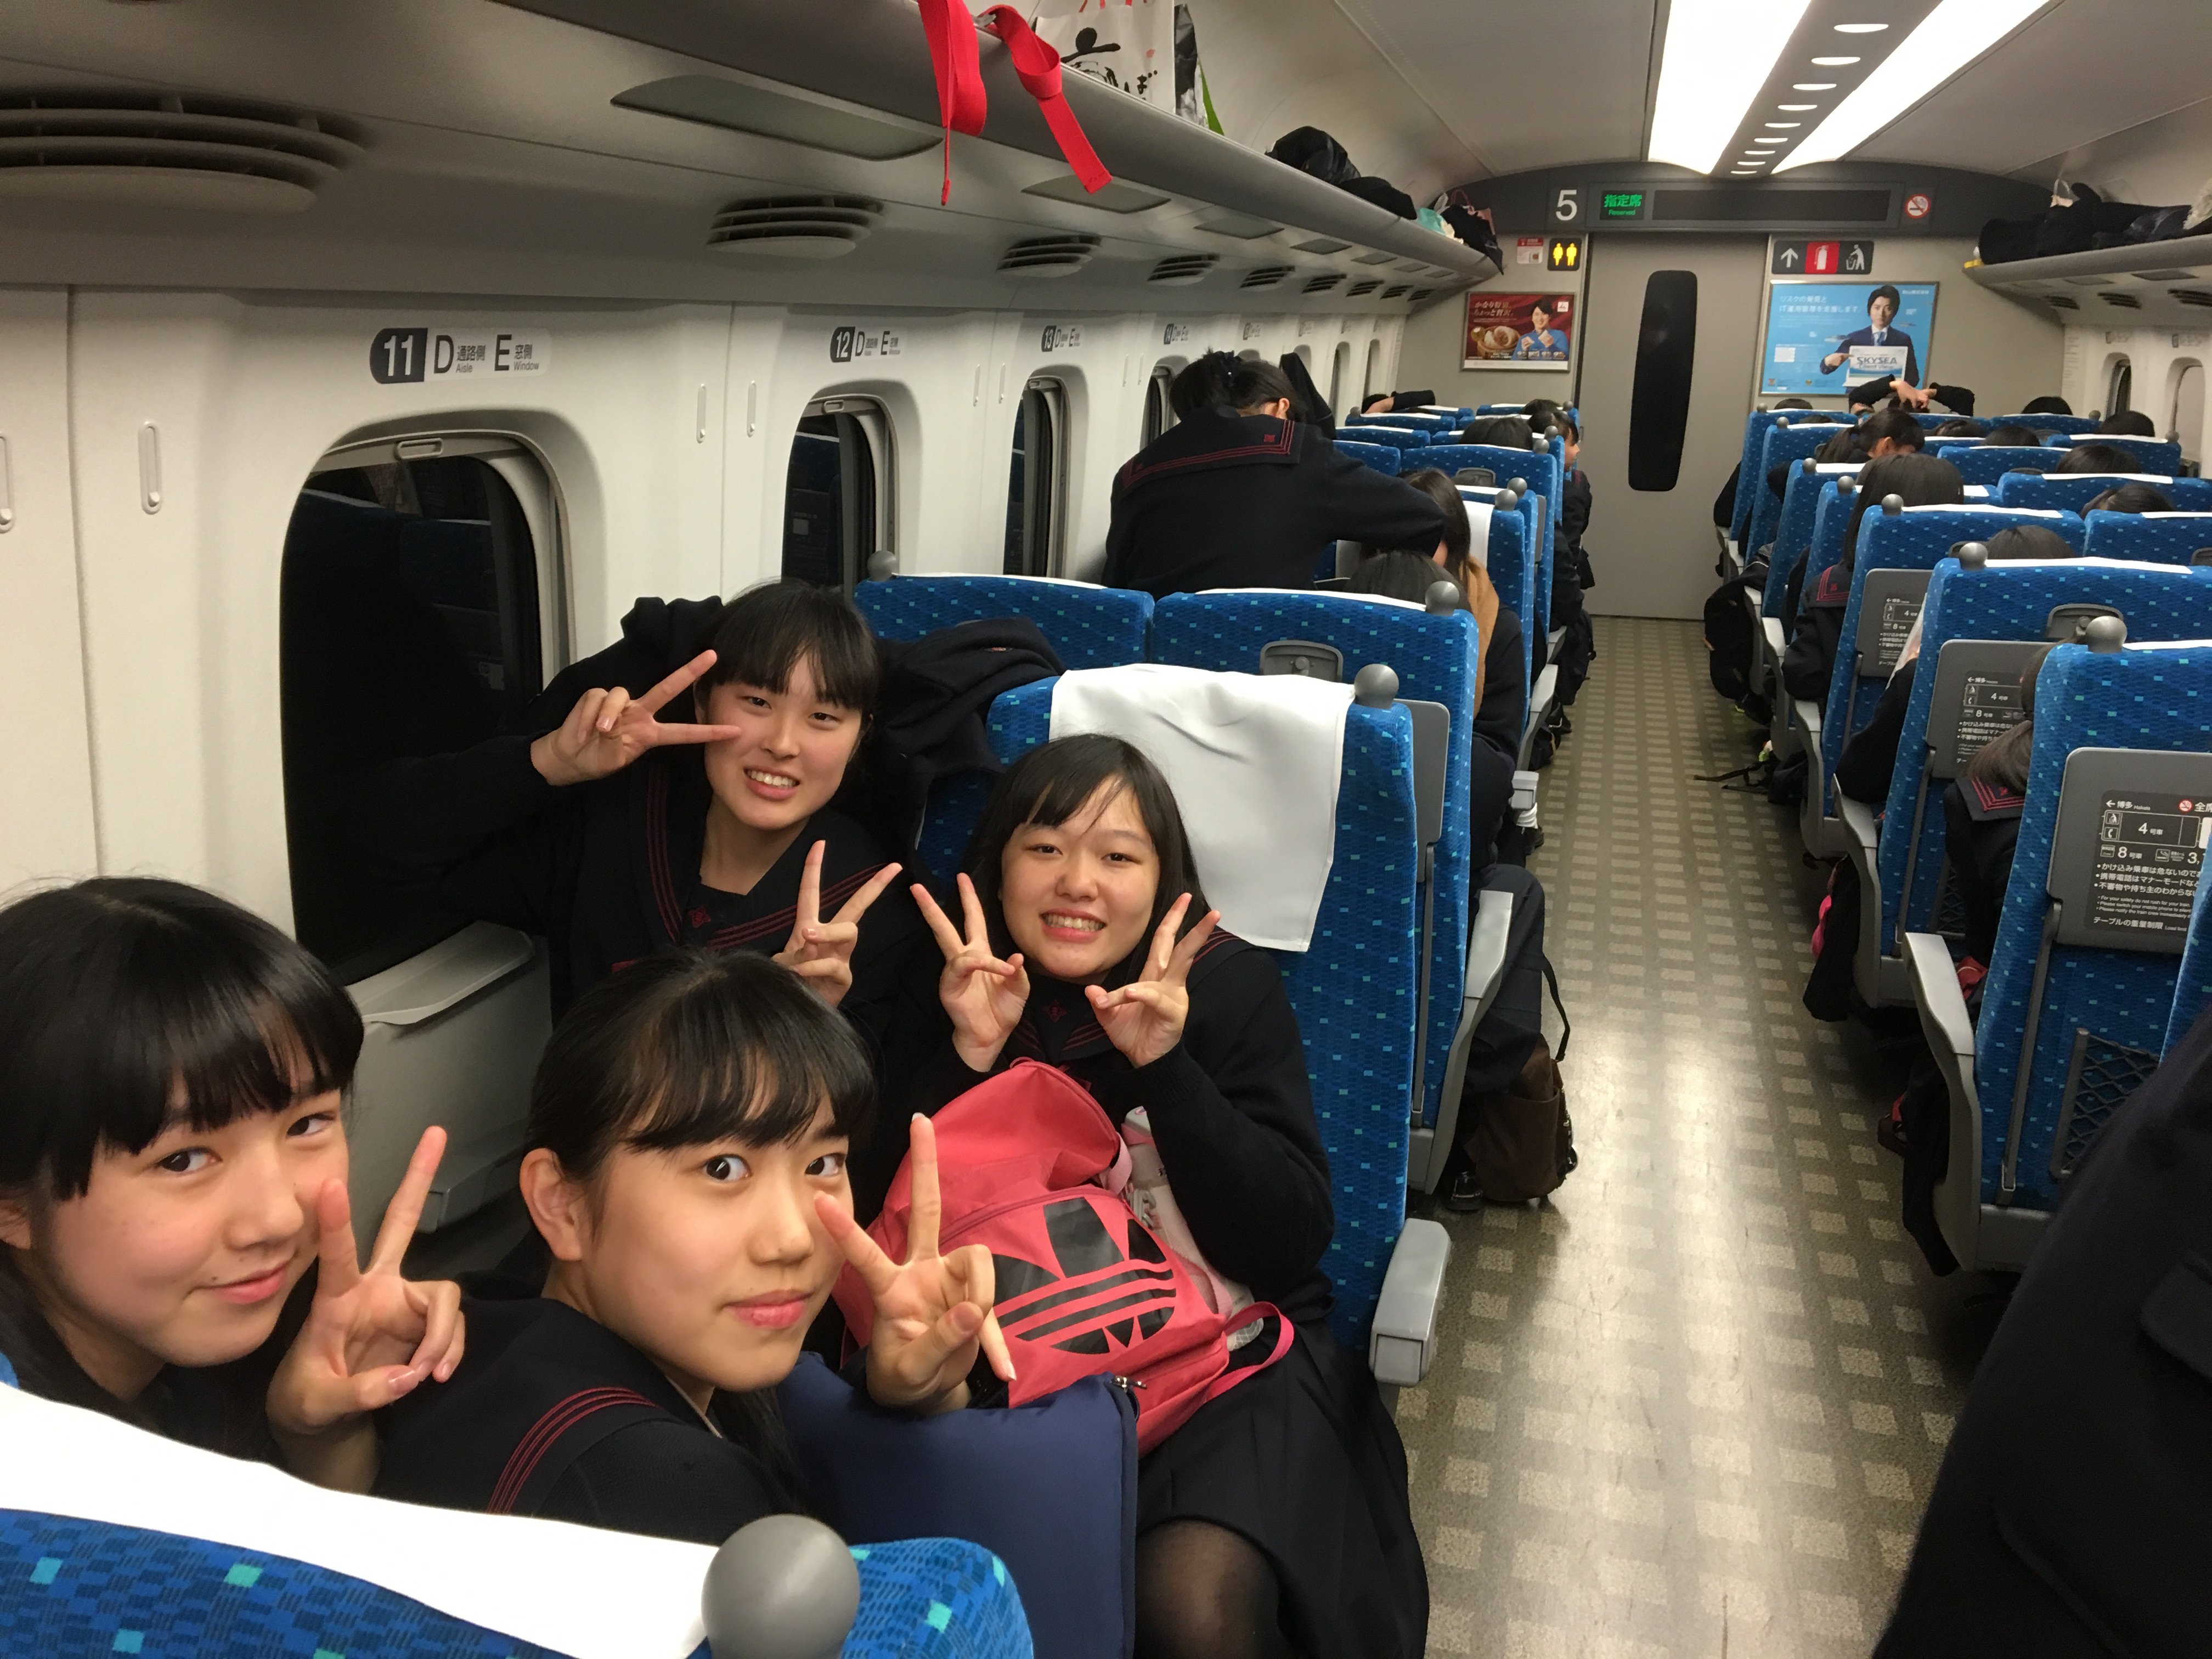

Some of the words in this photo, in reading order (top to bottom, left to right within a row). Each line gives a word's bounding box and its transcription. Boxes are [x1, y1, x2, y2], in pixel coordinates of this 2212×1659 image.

[1556, 189, 1577, 221] 5
[1604, 194, 1642, 207] 指定席
[836, 331, 850, 358] 12
[855, 331, 865, 357] D
[881, 331, 890, 356] E
[1045, 329, 1053, 349] 13
[1054, 329, 1062, 348] D
[1069, 328, 1076, 347] E
[384, 334, 413, 377] 11
[433, 335, 454, 374] D
[456, 345, 486, 362] 通路側
[494, 334, 512, 371] E
[514, 344, 533, 360] 窓側
[1857, 357, 1897, 365] SKYSEA
[456, 363, 473, 374] Aisle
[514, 362, 540, 371] Window
[1990, 692, 1997, 701] 4
[1976, 709, 1982, 718] 8
[2117, 800, 2133, 809] 博多
[2138, 822, 2148, 835] 4
[2118, 846, 2128, 859] 8
